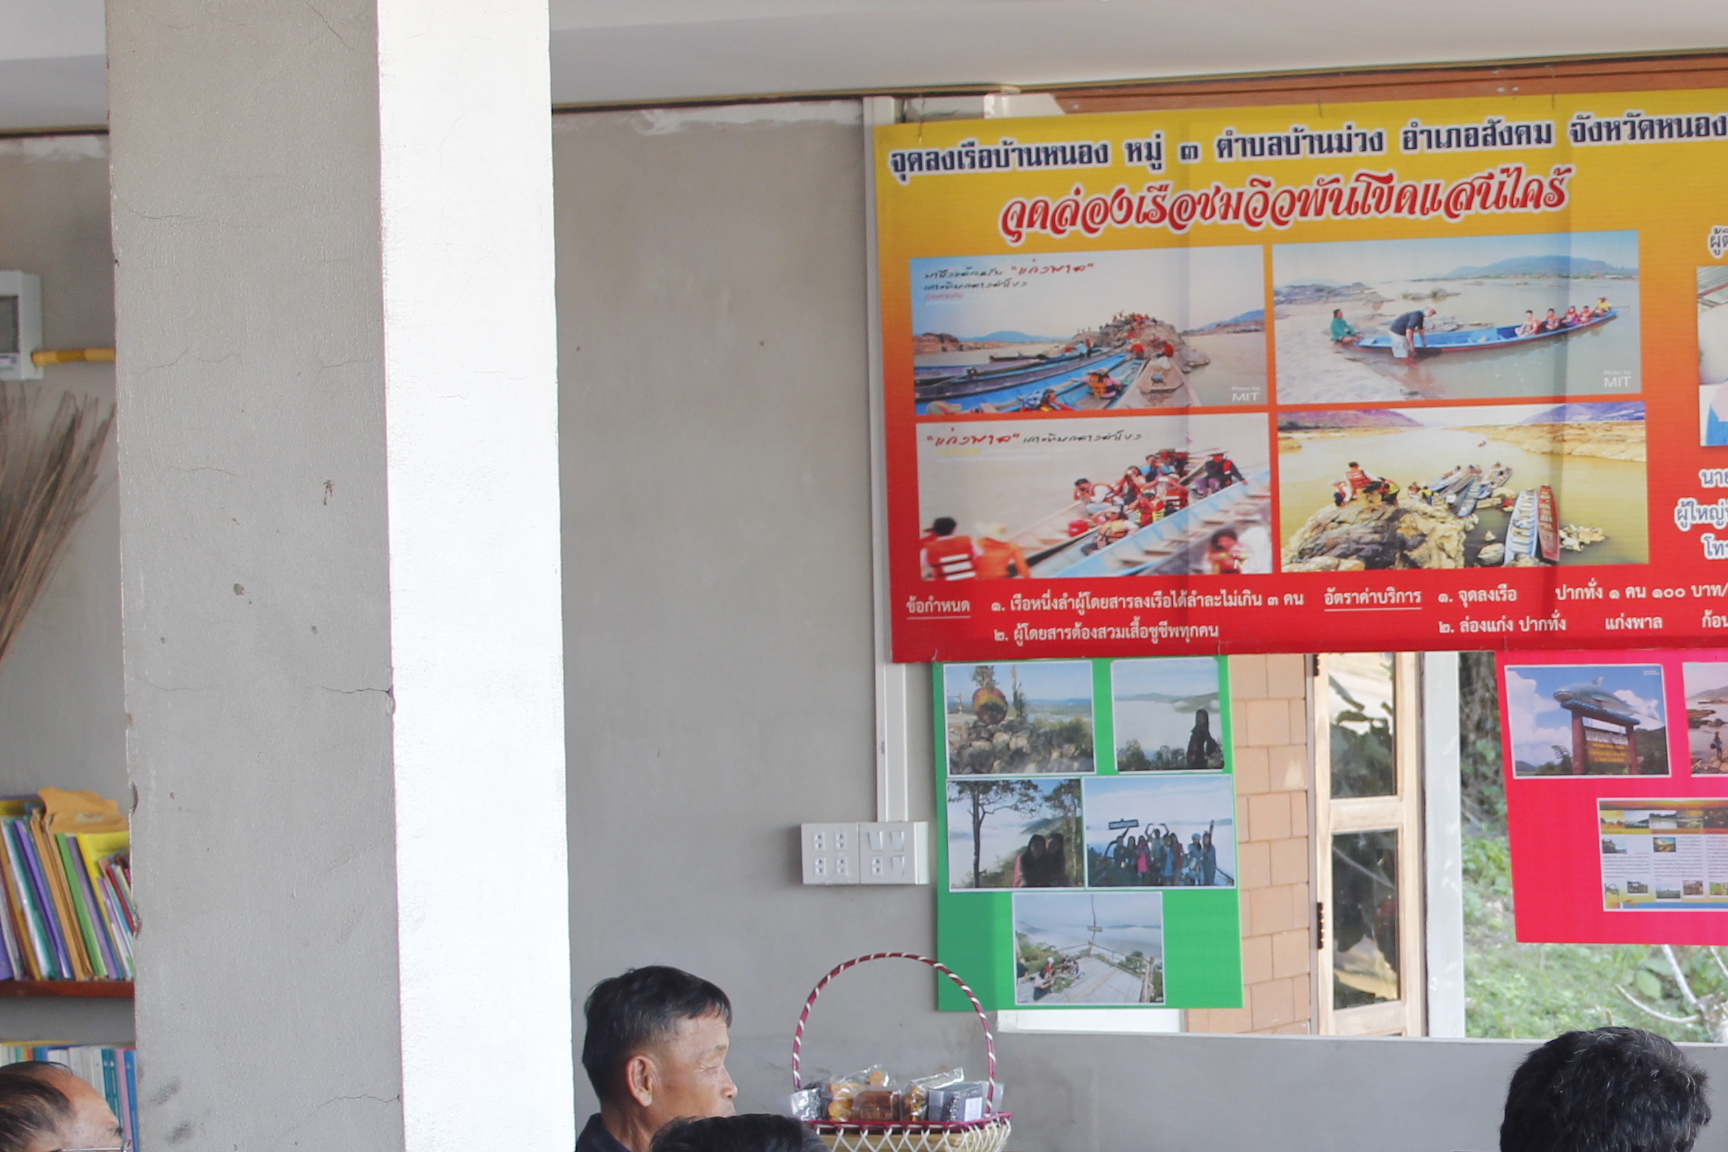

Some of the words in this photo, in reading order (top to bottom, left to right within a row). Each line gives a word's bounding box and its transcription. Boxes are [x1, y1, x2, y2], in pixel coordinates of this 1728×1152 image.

[891, 139, 1108, 182] จุดลงเรือบ้านหนอง
[1125, 133, 1162, 171] หมู่
[1180, 144, 1198, 160] ๓
[1216, 125, 1384, 158] ตำบลบ้านม่วง
[1402, 118, 1551, 151] อำเภอสังคม
[1603, 376, 1632, 388] MIT
[1267, 595, 1279, 606] ๓
[1283, 593, 1304, 606] คน
[1324, 587, 1422, 605] อัตราค่าบริการ
[1458, 583, 1517, 608] จุดลงเรือ
[1625, 585, 1646, 599] คน
[1652, 587, 1686, 599] ๑๐๐
[906, 595, 970, 613] ข้อกำหนด
[1459, 615, 1514, 633] ล่องแก่ง
[1605, 612, 1663, 631] แก่งพาล
[1013, 616, 1219, 647] ผู้โดยสารต้องสวมเสื้อชูชีพทุกคน
